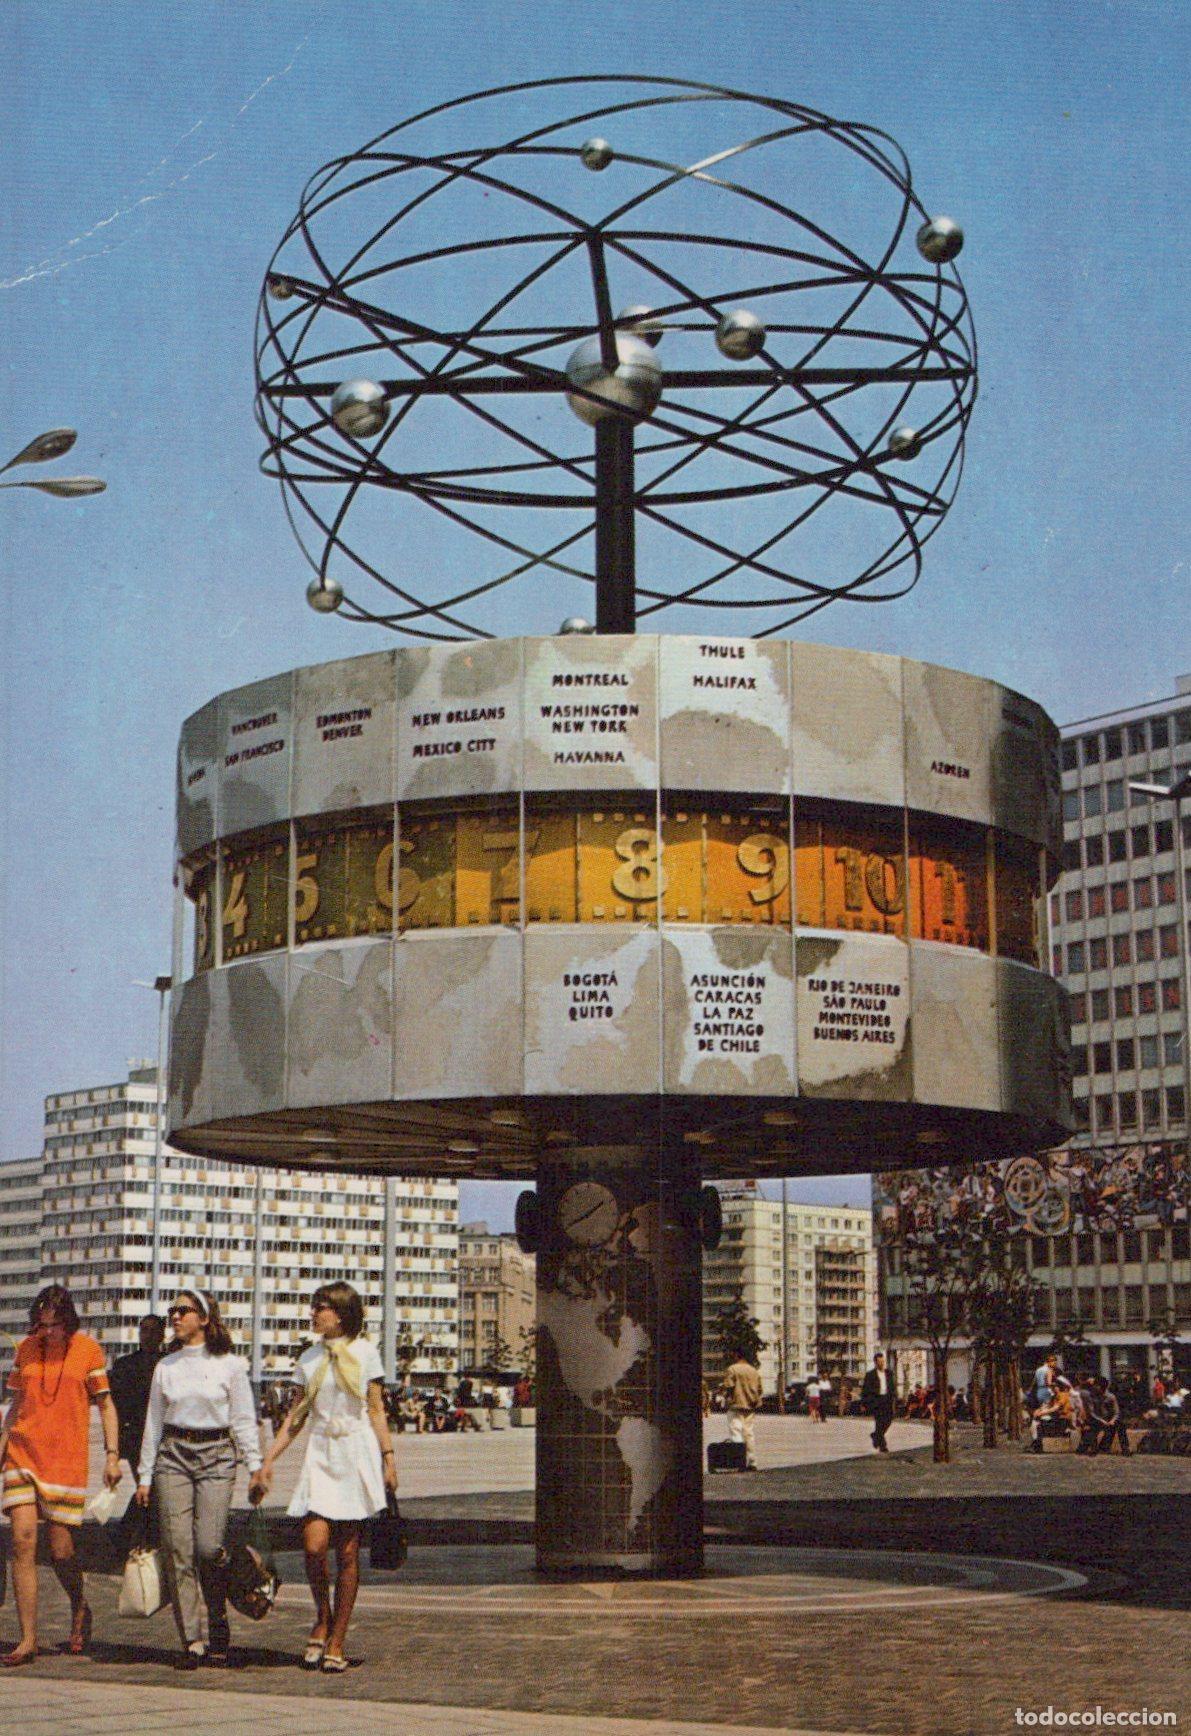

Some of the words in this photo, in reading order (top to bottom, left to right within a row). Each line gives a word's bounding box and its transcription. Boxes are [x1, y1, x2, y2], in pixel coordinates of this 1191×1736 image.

[699, 644, 745, 659] THULE
[552, 674, 629, 687] MONTREAL
[693, 675, 757, 690] HALIFAX
[412, 712, 441, 728] NEW
[446, 706, 505, 724] ORLEANS
[540, 704, 640, 718] WASHINGTON
[322, 724, 363, 742] DENVER
[552, 720, 584, 734] NEW
[590, 720, 628, 733] YORK
[412, 741, 462, 758] MEXICO
[467, 738, 496, 752] CITY
[553, 751, 625, 764] HAVANNA
[222, 871, 249, 938] 4
[292, 853, 320, 923] 5
[374, 840, 421, 912] 6
[481, 831, 541, 905] 7
[610, 828, 669, 903] 8
[736, 833, 791, 906] 9
[835, 846, 907, 916] 10
[563, 970, 618, 987] BOGOTÁ
[690, 972, 766, 988] ASUNCIÓN
[808, 979, 828, 992] RIO
[831, 980, 845, 993] DE
[848, 981, 901, 997] JANEIRO
[573, 990, 610, 1003] LIMA
[694, 989, 763, 1005] CARACAS
[850, 997, 887, 1011] PAULO
[568, 1005, 614, 1021] QUITO
[703, 1006, 722, 1019] LA
[728, 1007, 754, 1020] PAZ
[819, 1011, 891, 1027] MONTEVIDEO
[694, 1022, 765, 1037] SANTIAGO
[814, 1027, 859, 1042] BUENOS
[861, 1030, 896, 1043] AIRES
[698, 1039, 715, 1051] DE
[720, 1039, 760, 1053] CHILE
